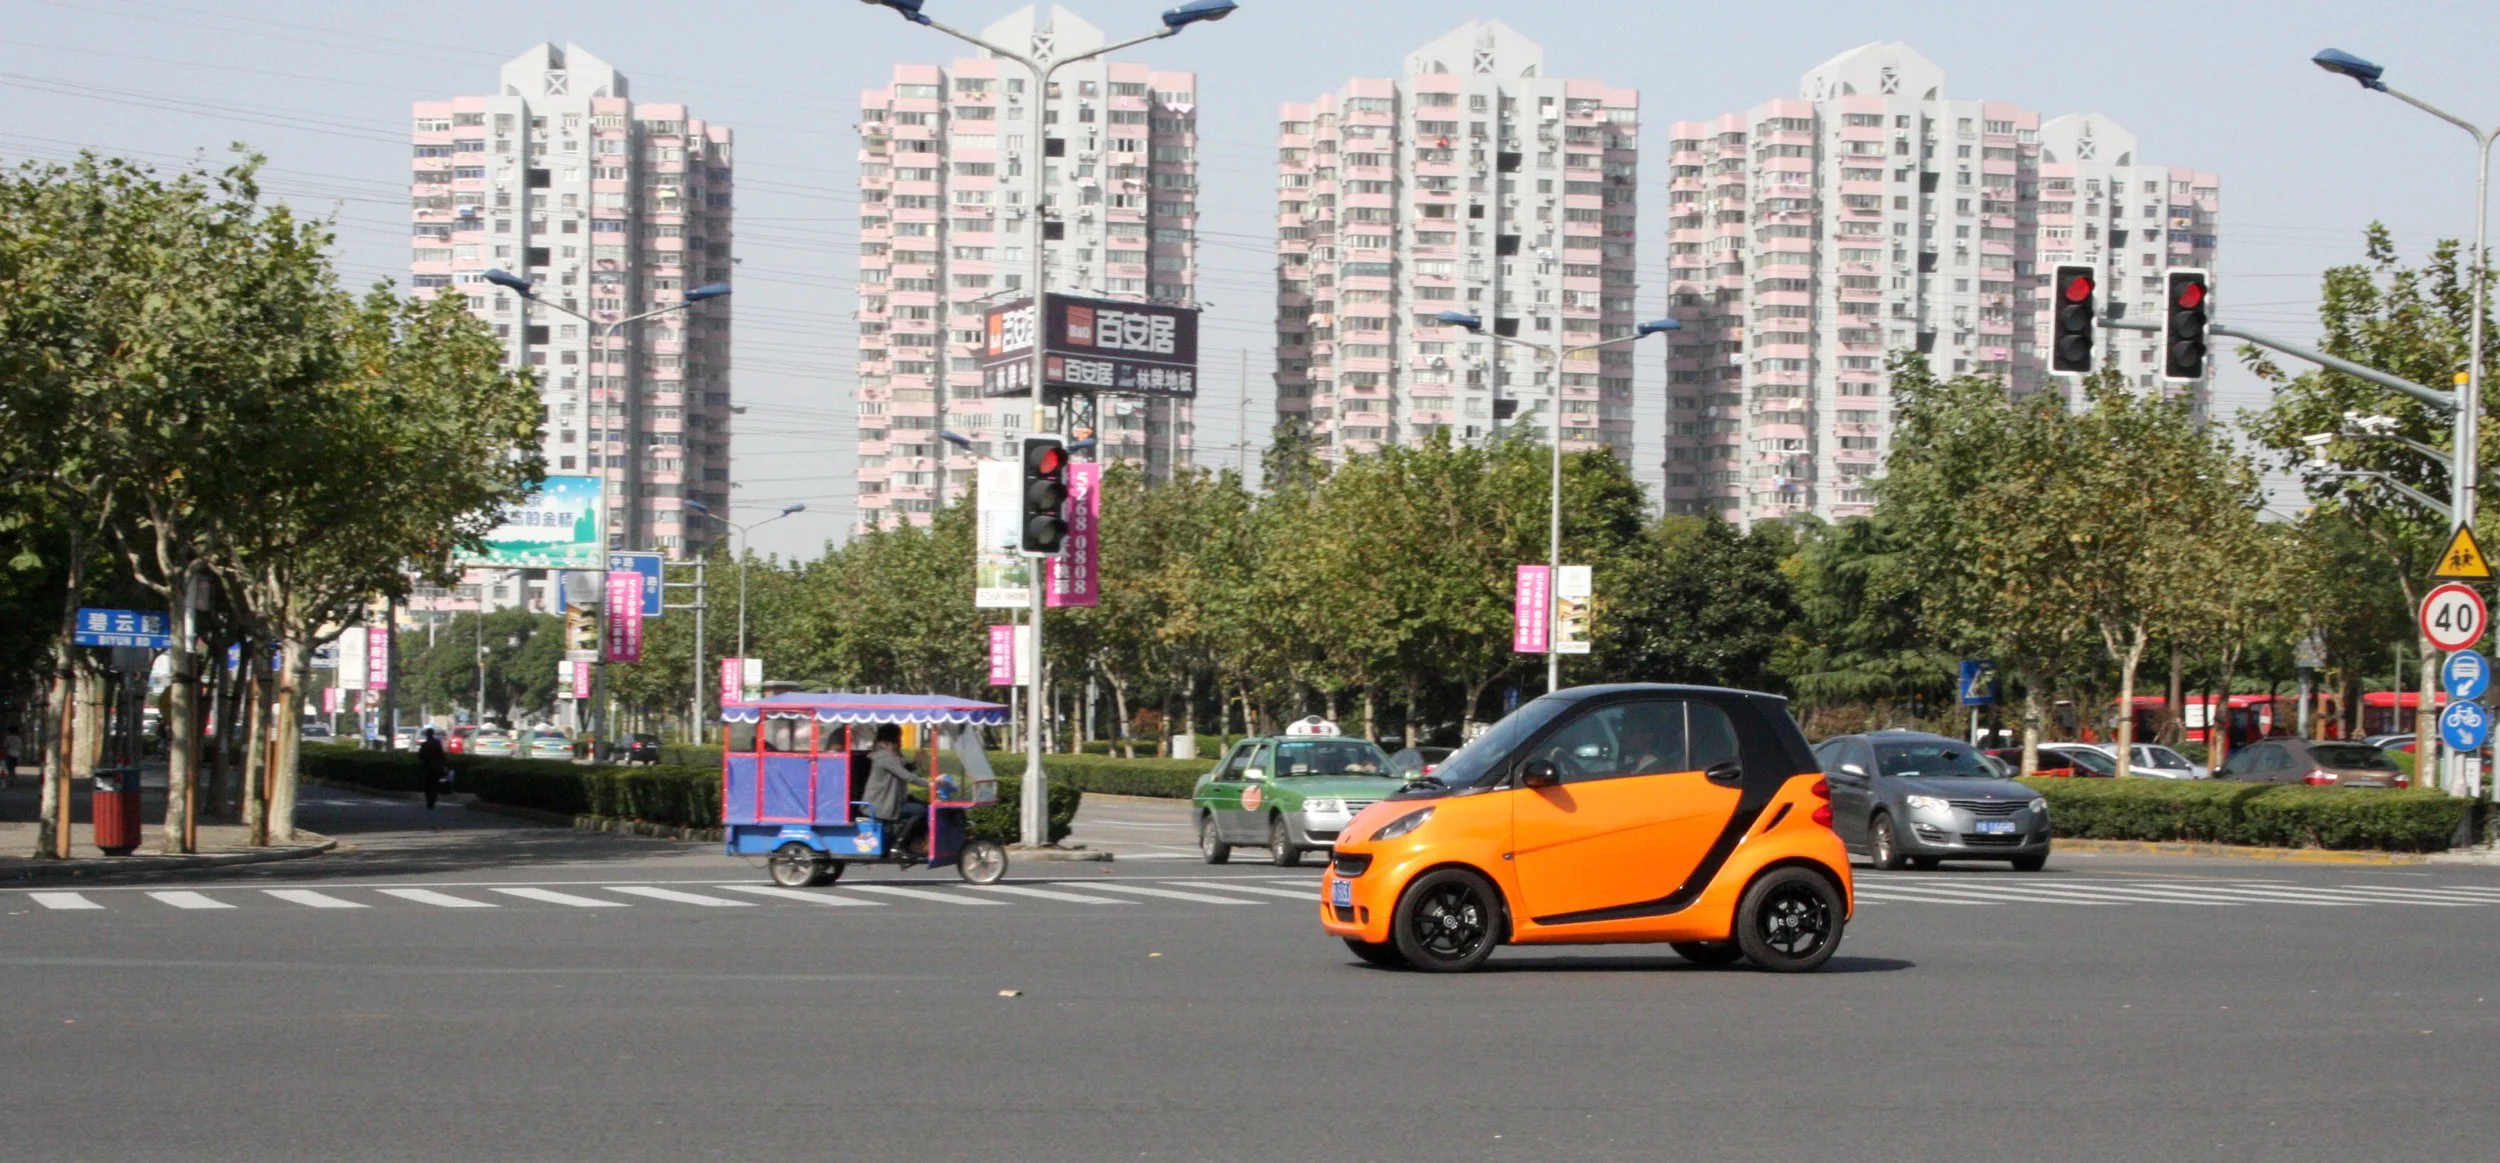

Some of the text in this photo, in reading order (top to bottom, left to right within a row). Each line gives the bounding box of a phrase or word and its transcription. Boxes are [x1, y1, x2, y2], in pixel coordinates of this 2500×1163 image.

[1096, 309, 1176, 353] 百安居
[1064, 358, 1115, 387] 百安居
[1074, 472, 1088, 594] 5268 0808
[88, 612, 161, 634] 碧云路
[2435, 603, 2473, 633] 40
